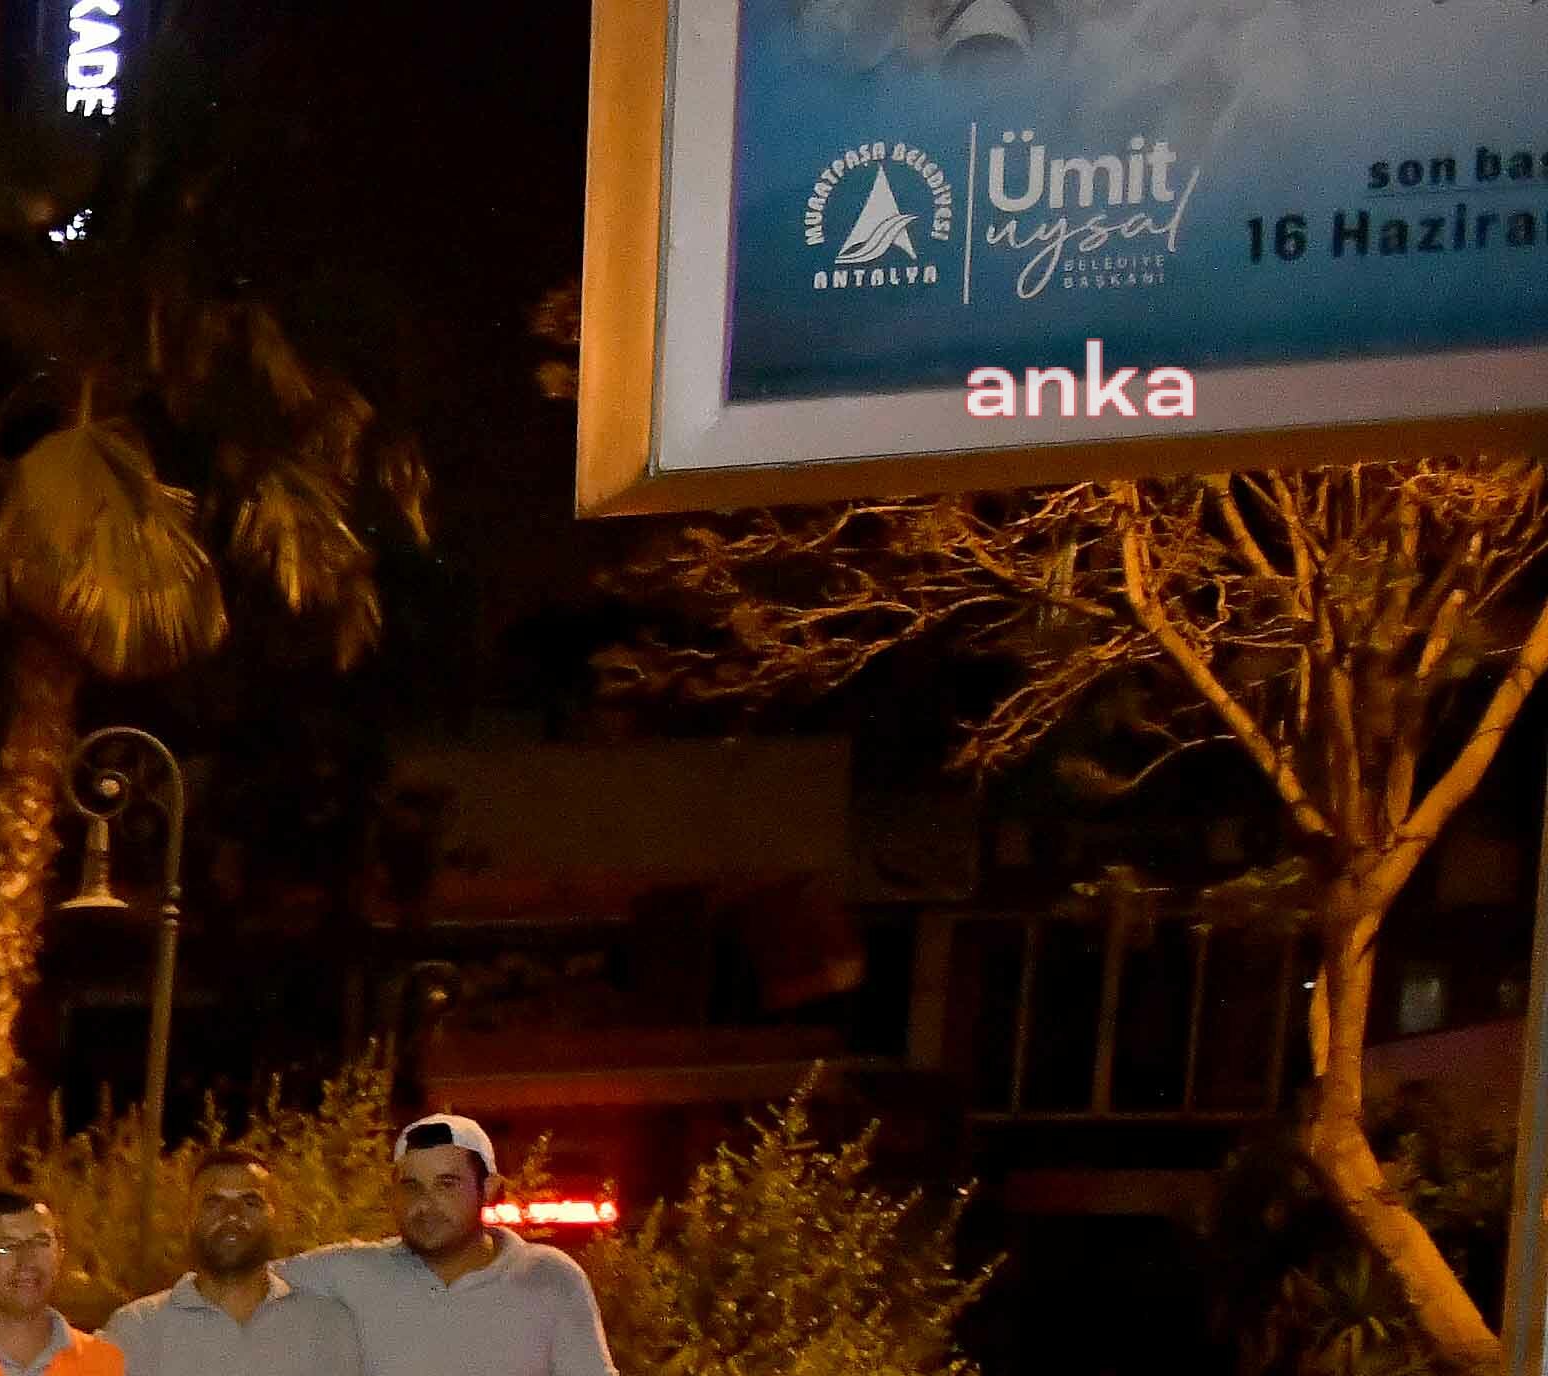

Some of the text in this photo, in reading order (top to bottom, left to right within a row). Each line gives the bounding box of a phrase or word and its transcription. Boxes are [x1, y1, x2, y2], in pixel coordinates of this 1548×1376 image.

[988, 128, 1178, 213] Ümit
[1367, 157, 1457, 190] son
[1245, 202, 1548, 265] 16 Hazira
[813, 264, 938, 290] ANTALYA
